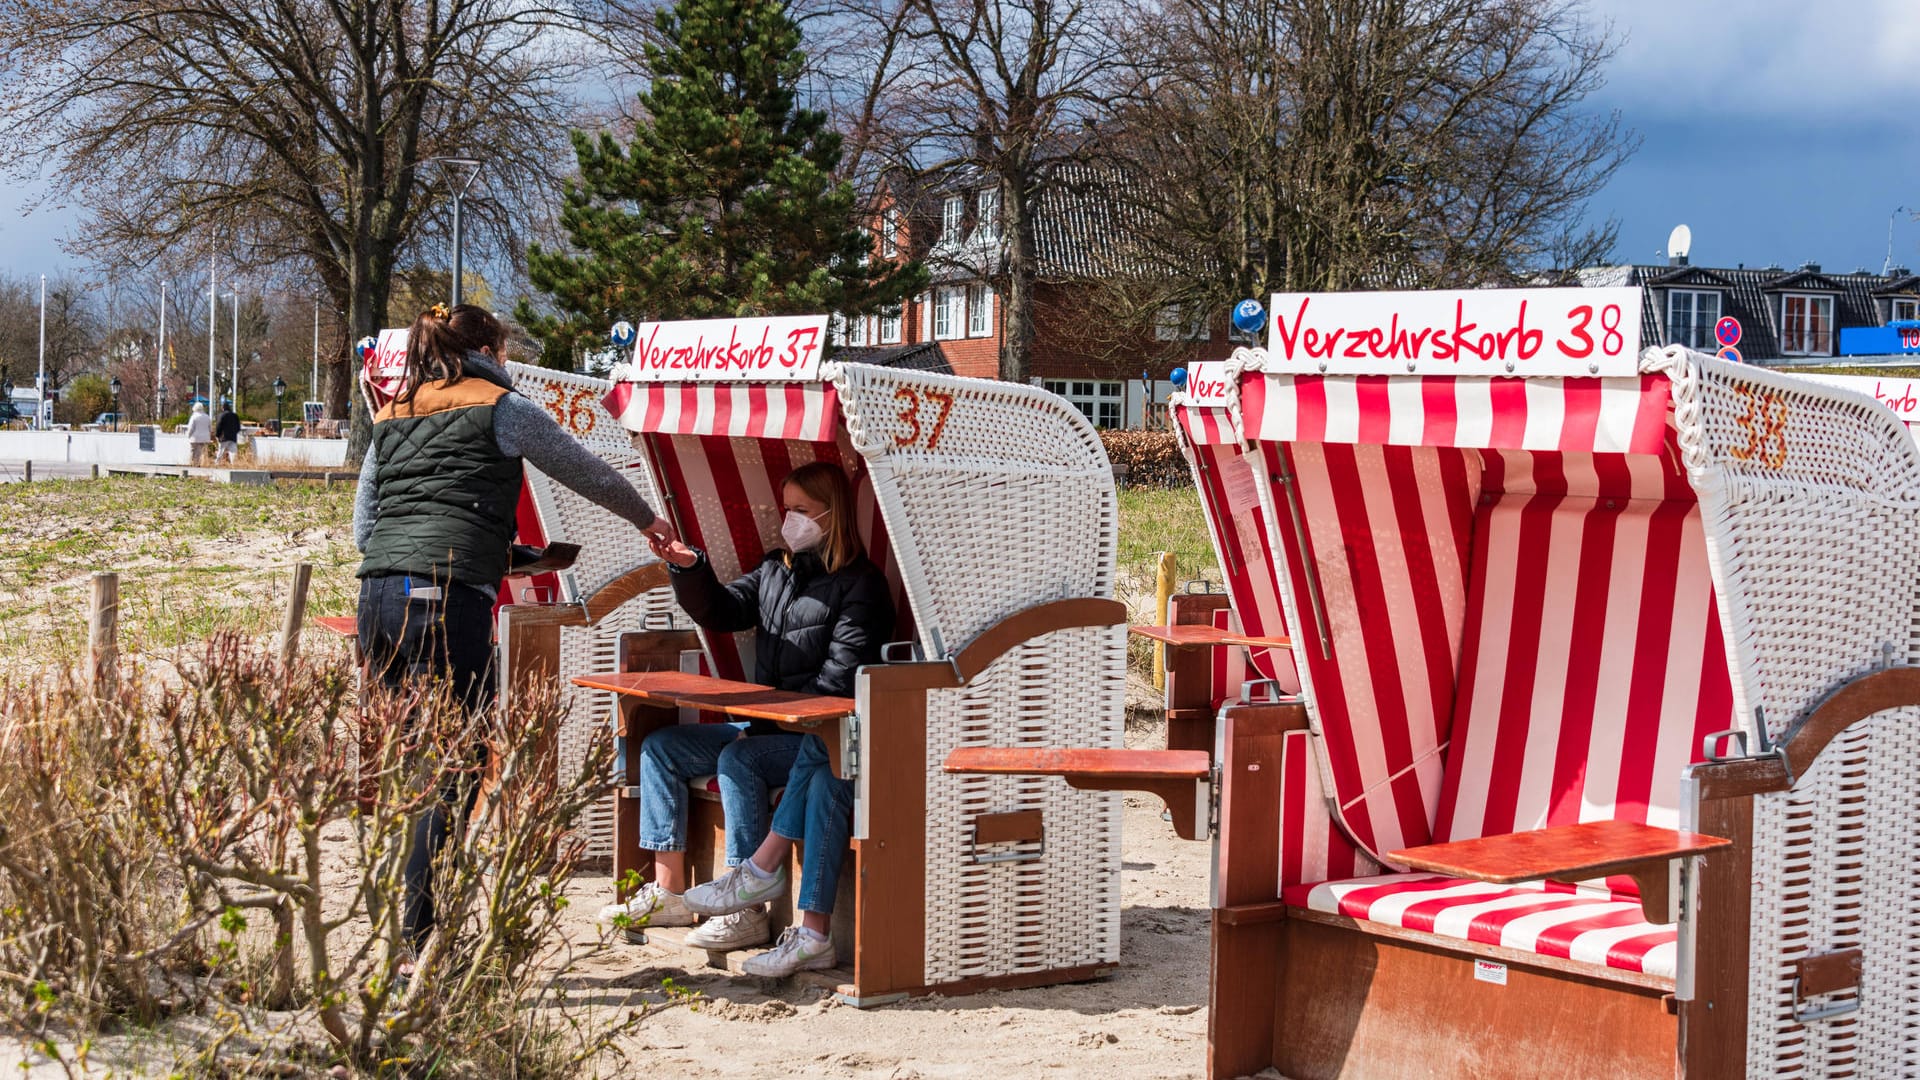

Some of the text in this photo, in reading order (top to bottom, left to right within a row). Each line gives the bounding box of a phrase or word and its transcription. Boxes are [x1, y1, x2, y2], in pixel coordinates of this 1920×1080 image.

[640, 324, 819, 372] Verzehrskorb 37
[1278, 297, 1624, 363] Verzehrskorb 38
[1188, 363, 1225, 399] Verz
[544, 384, 596, 435] 36
[894, 387, 955, 449] 37
[1731, 384, 1787, 468] 38
